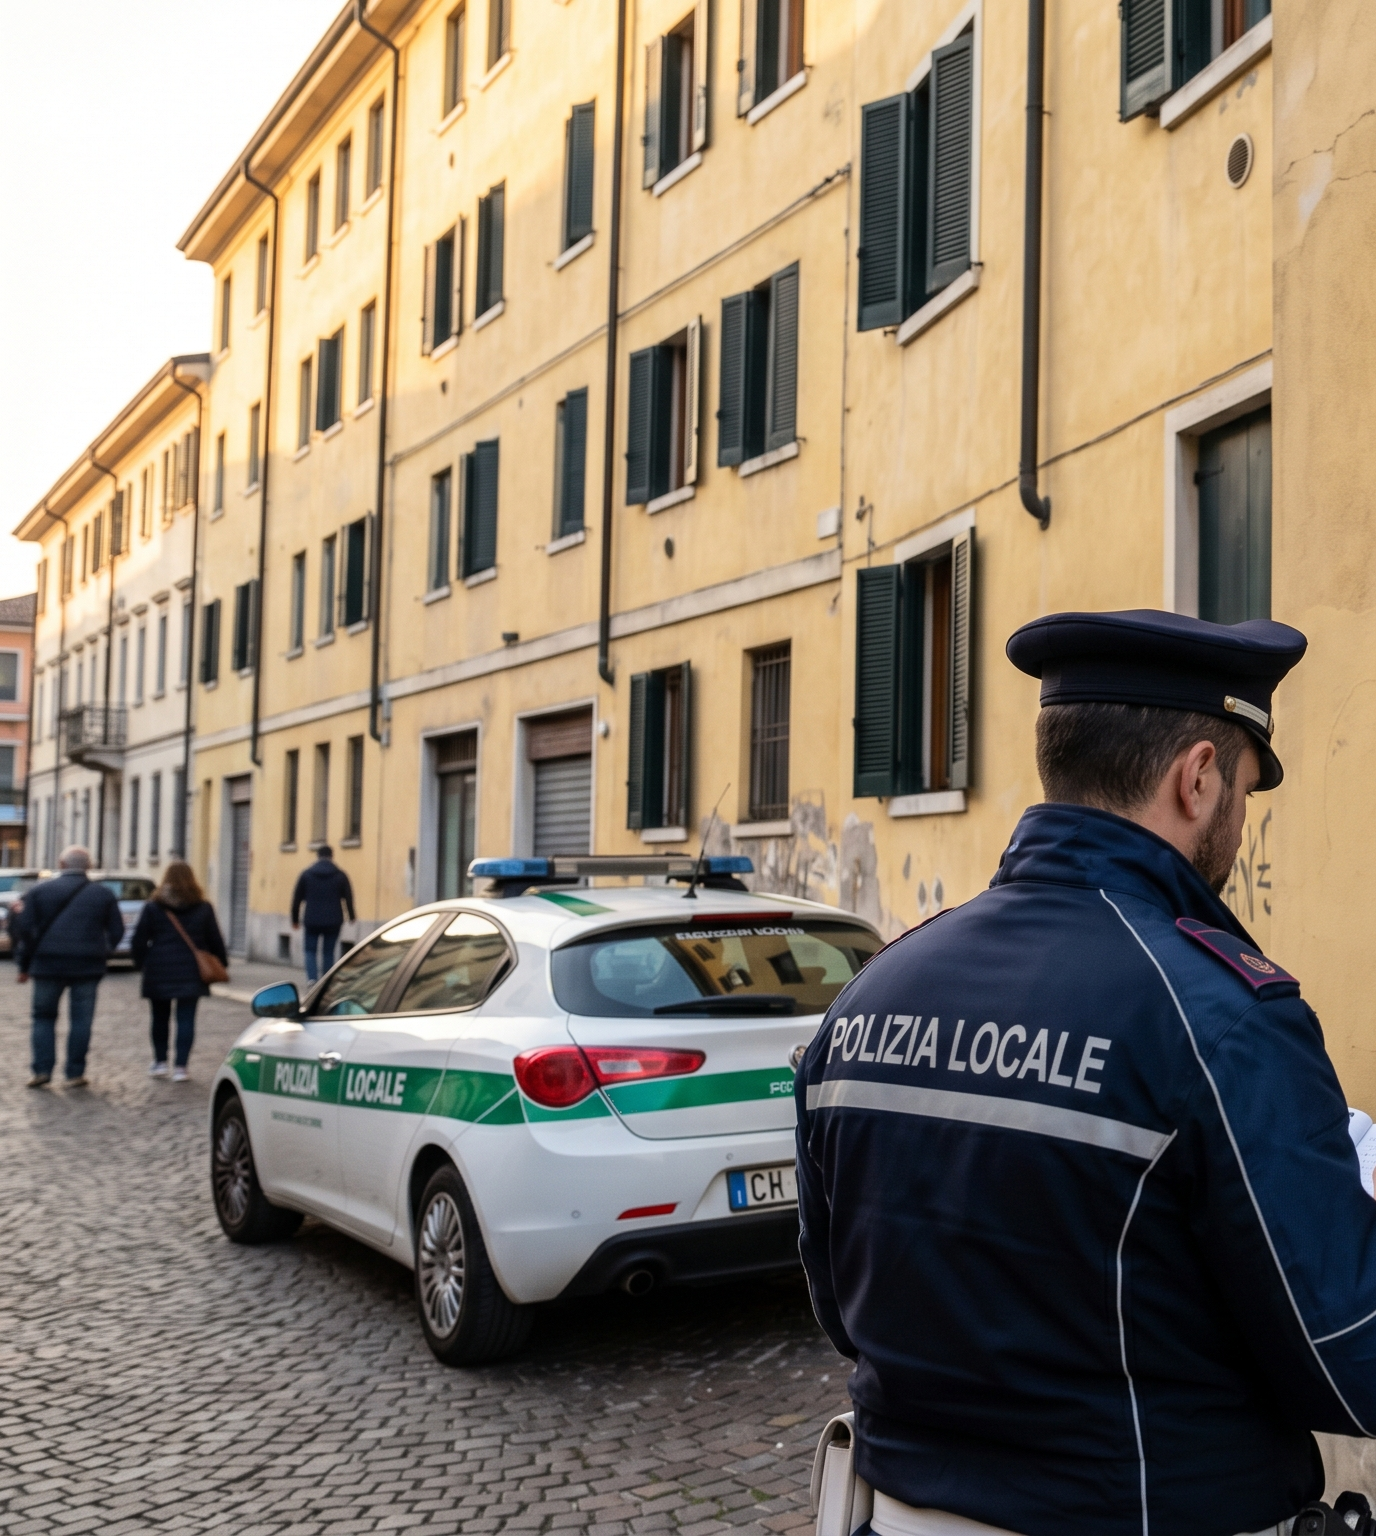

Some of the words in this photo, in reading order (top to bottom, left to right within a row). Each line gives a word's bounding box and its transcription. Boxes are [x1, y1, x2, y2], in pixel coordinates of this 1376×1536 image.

[827, 1014, 939, 1069] POLIZIA
[947, 1019, 1112, 1094] LOCALE
[274, 1062, 319, 1097] POLIZIA
[345, 1068, 407, 1106] LOCALE
[751, 1170, 785, 1202] CH
